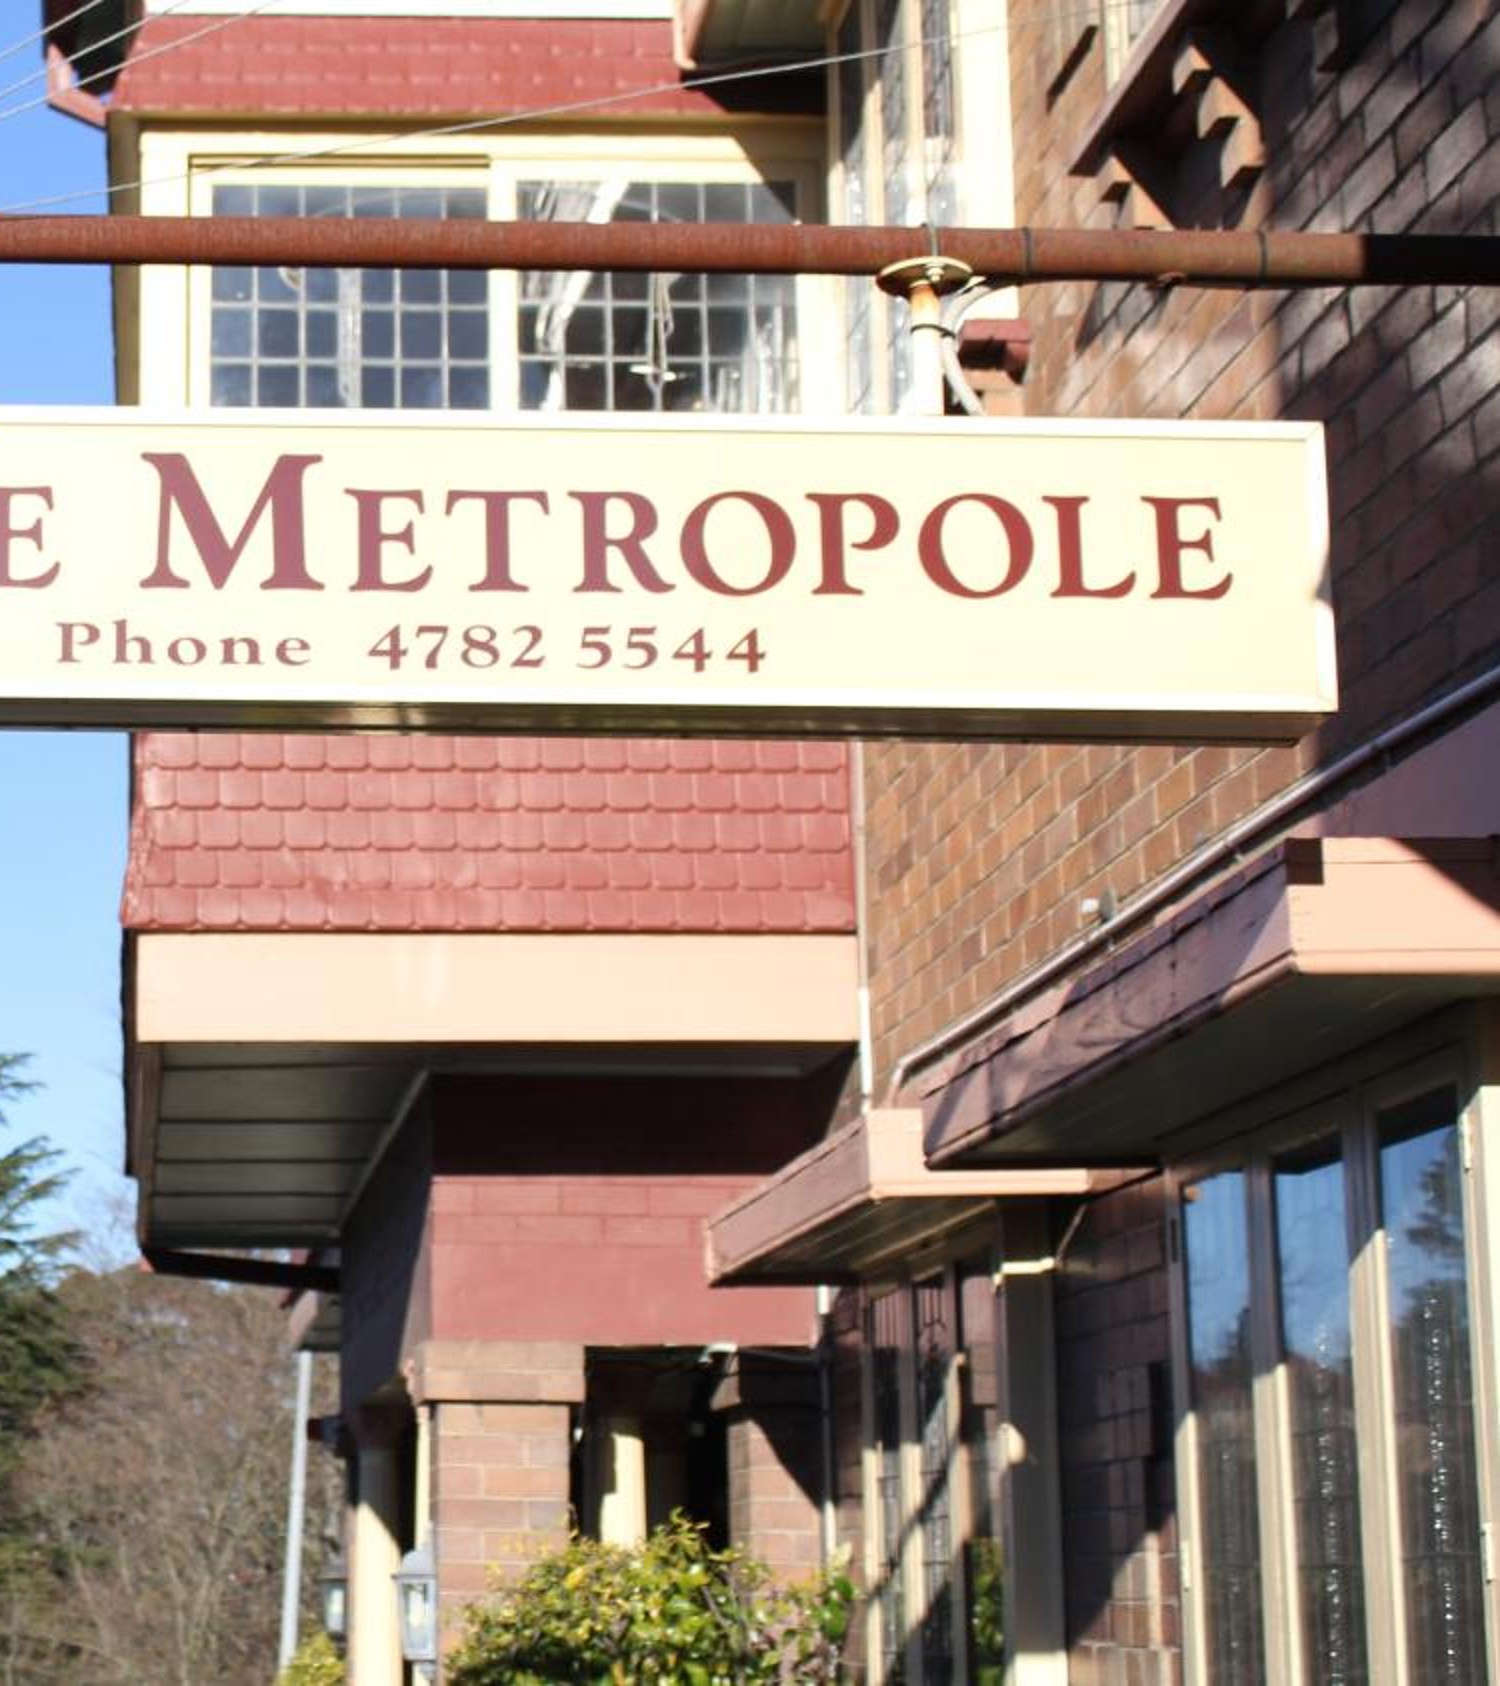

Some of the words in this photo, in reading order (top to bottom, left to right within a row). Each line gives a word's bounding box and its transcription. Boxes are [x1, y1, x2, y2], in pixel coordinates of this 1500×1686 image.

[139, 451, 1234, 601] METROPOLE
[56, 618, 311, 667] Phone
[367, 625, 546, 671] 4782
[579, 625, 767, 673] 5544
